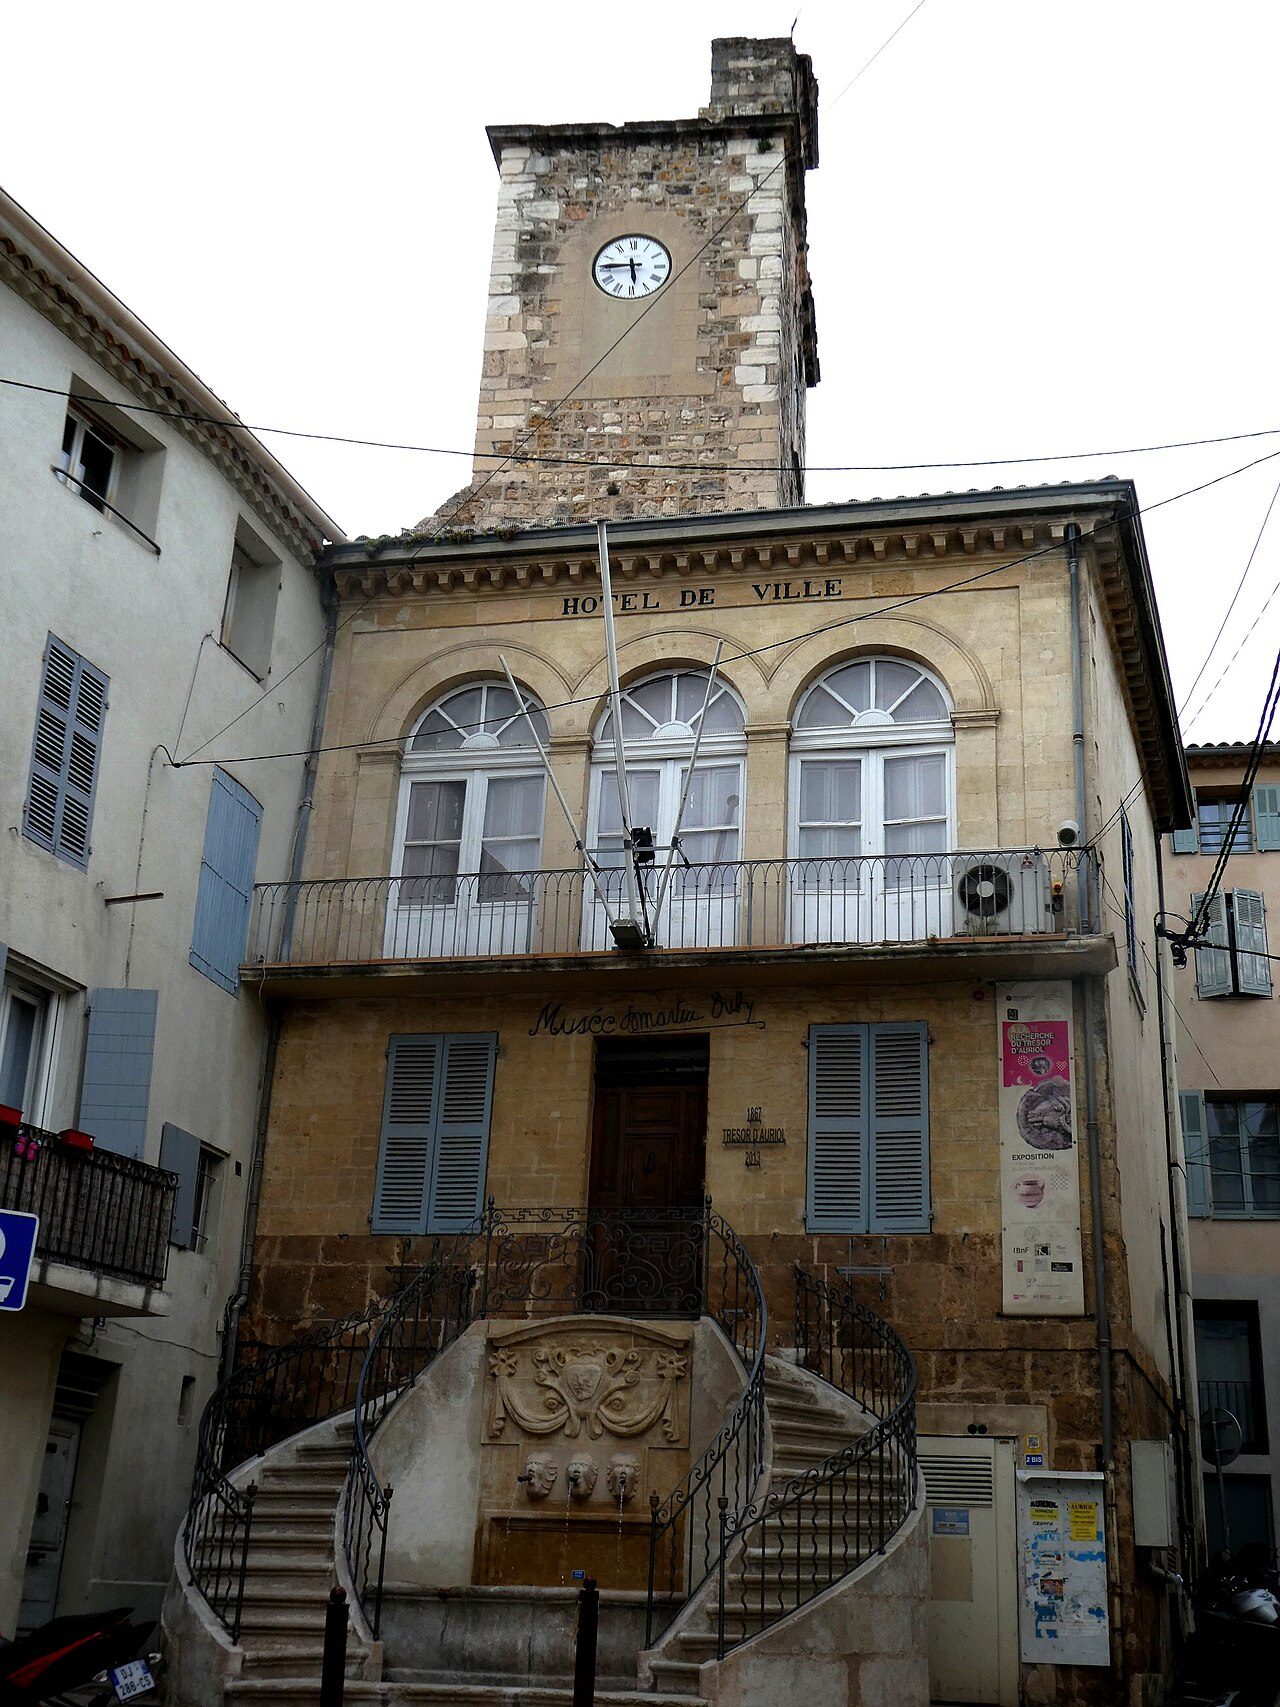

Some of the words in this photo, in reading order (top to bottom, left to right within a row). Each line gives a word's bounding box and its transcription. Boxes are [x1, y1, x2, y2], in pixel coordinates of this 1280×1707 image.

[679, 588, 715, 607] DE
[751, 579, 843, 600] VILLE
[528, 1001, 615, 1036] Musée
[1011, 1032, 1054, 1041] RECHERCHE
[1011, 1040, 1021, 1048] DU
[1011, 1046, 1044, 1054] D'AURIOL
[722, 1128, 751, 1142] TRESOR
[1012, 1152, 1054, 1161] EXPOSITION
